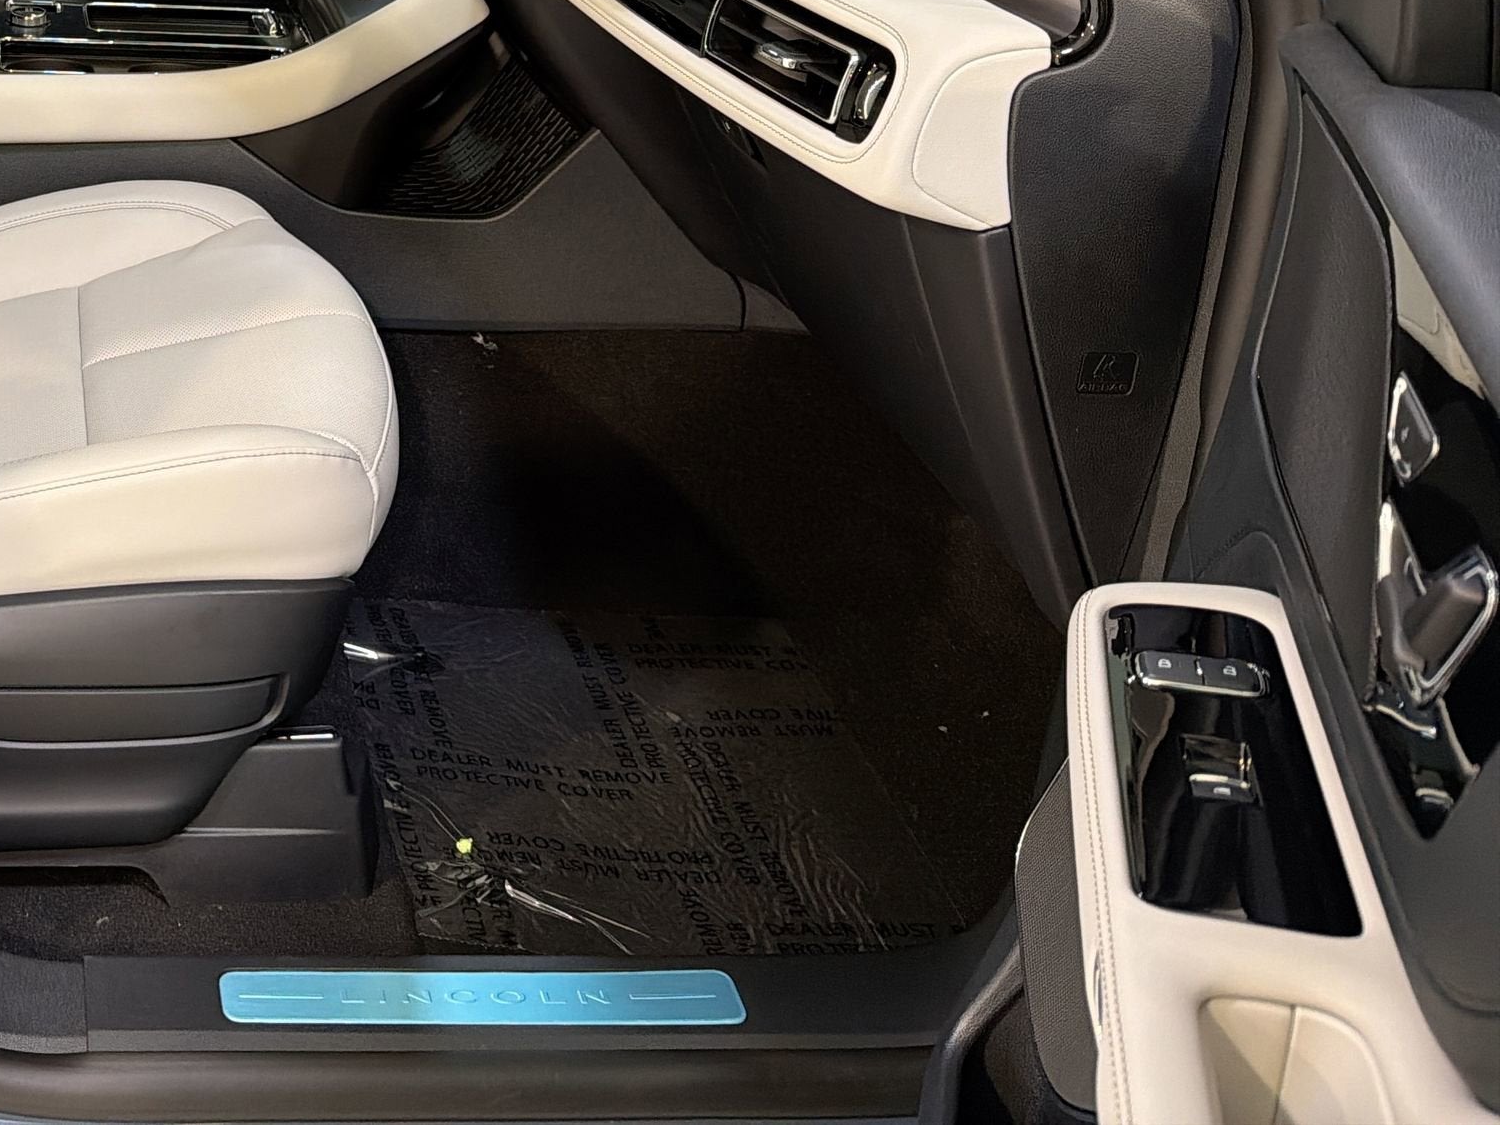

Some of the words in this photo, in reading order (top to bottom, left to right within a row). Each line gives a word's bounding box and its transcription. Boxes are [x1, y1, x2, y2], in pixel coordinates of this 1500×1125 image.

[593, 642, 628, 686] COVER
[634, 657, 756, 671] PROTECTIVE
[581, 671, 614, 711] MUST
[615, 690, 668, 771] PROTECTIVE
[668, 725, 761, 739] REMOVE
[706, 708, 781, 722] COVER
[603, 717, 639, 770] DEALER
[409, 747, 492, 768] DEALER
[505, 756, 565, 778] MUST
[577, 768, 675, 786] REMOVE
[416, 764, 548, 793] PROTECTIVE
[556, 781, 635, 802] COVER
[486, 830, 566, 852] COVER
[574, 841, 714, 866] PROTECTIVE
[720, 831, 762, 885] COVER
[634, 867, 722, 885] DEALER
[676, 886, 724, 956] REMOVE
[339, 987, 612, 1005] LINCOLN
